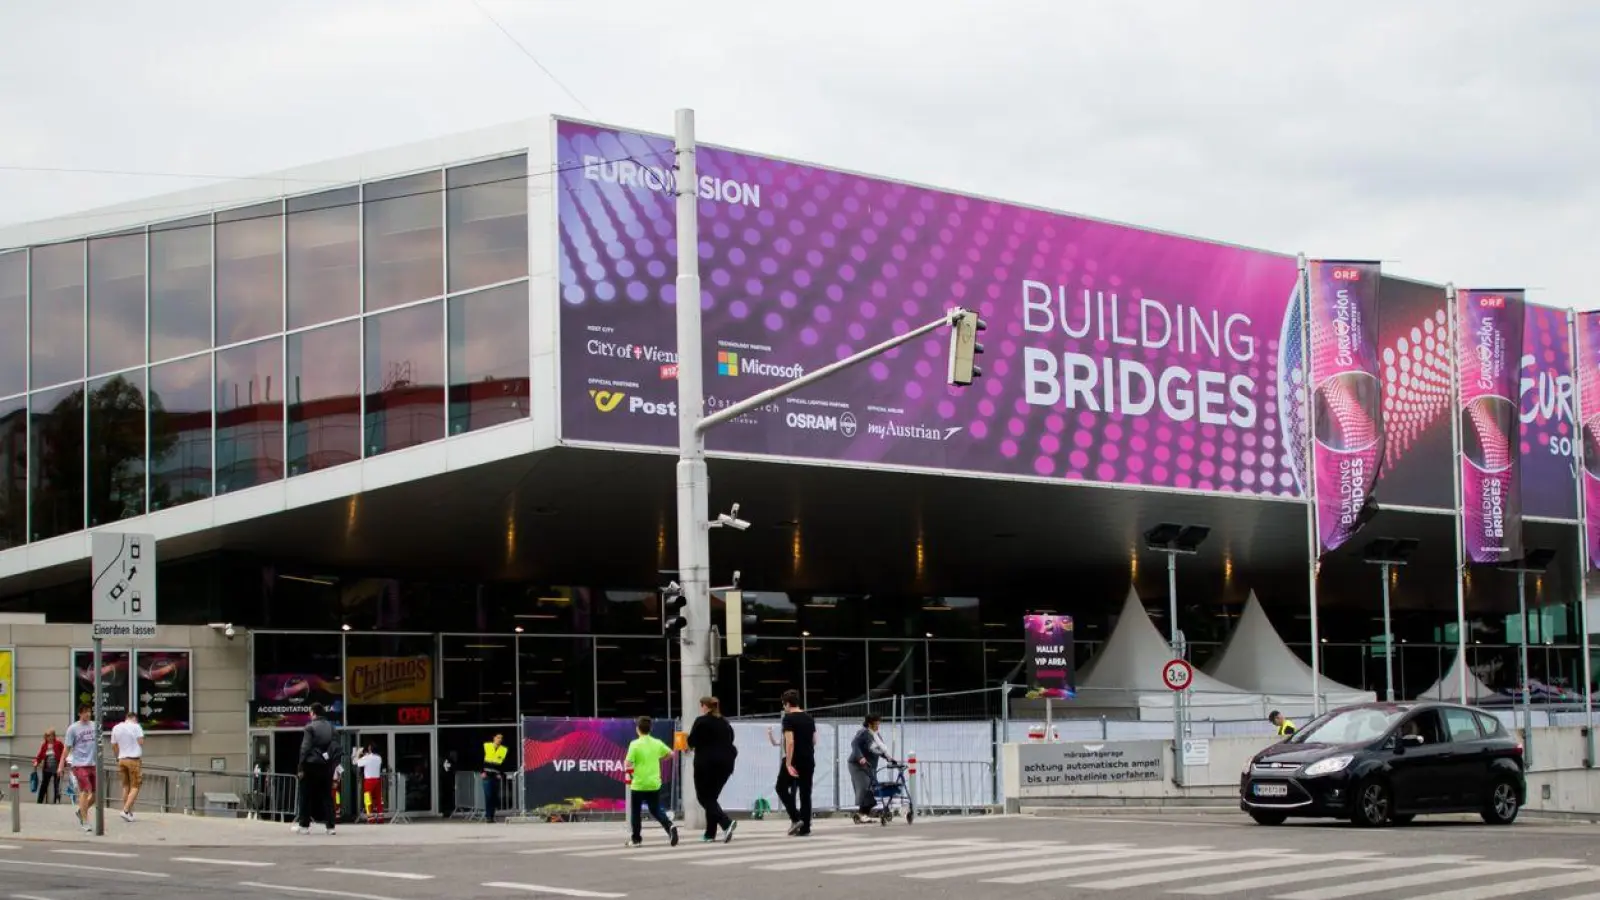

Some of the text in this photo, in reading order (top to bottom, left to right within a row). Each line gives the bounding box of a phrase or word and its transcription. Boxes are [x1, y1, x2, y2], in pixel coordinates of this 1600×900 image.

[1333, 270, 1357, 279] ORF
[1480, 298, 1503, 307] ORF
[1022, 279, 1255, 362] BUILDING
[617, 344, 633, 359] of
[741, 357, 804, 378] Microsoft
[1023, 346, 1257, 428] BRIDGES
[629, 395, 677, 417] Post
[786, 412, 837, 431] OSRAM
[1341, 459, 1353, 524] BUILDING
[1352, 458, 1364, 522] RIDGES
[1482, 478, 1494, 538] BUILDING
[1491, 478, 1504, 538] BRIDGES
[94, 623, 156, 635] Einordnen lassen
[1036, 645, 1058, 653] HALLE
[1034, 657, 1067, 666] VIP AREA
[397, 706, 430, 723] OPEN
[552, 759, 625, 772] VIP ENTRA
[1024, 762, 1063, 772] achtung
[1066, 760, 1129, 770] automatische
[1027, 775, 1042, 783] bis
[1046, 775, 1060, 783] zur
[1064, 772, 1107, 781] haltelinie
